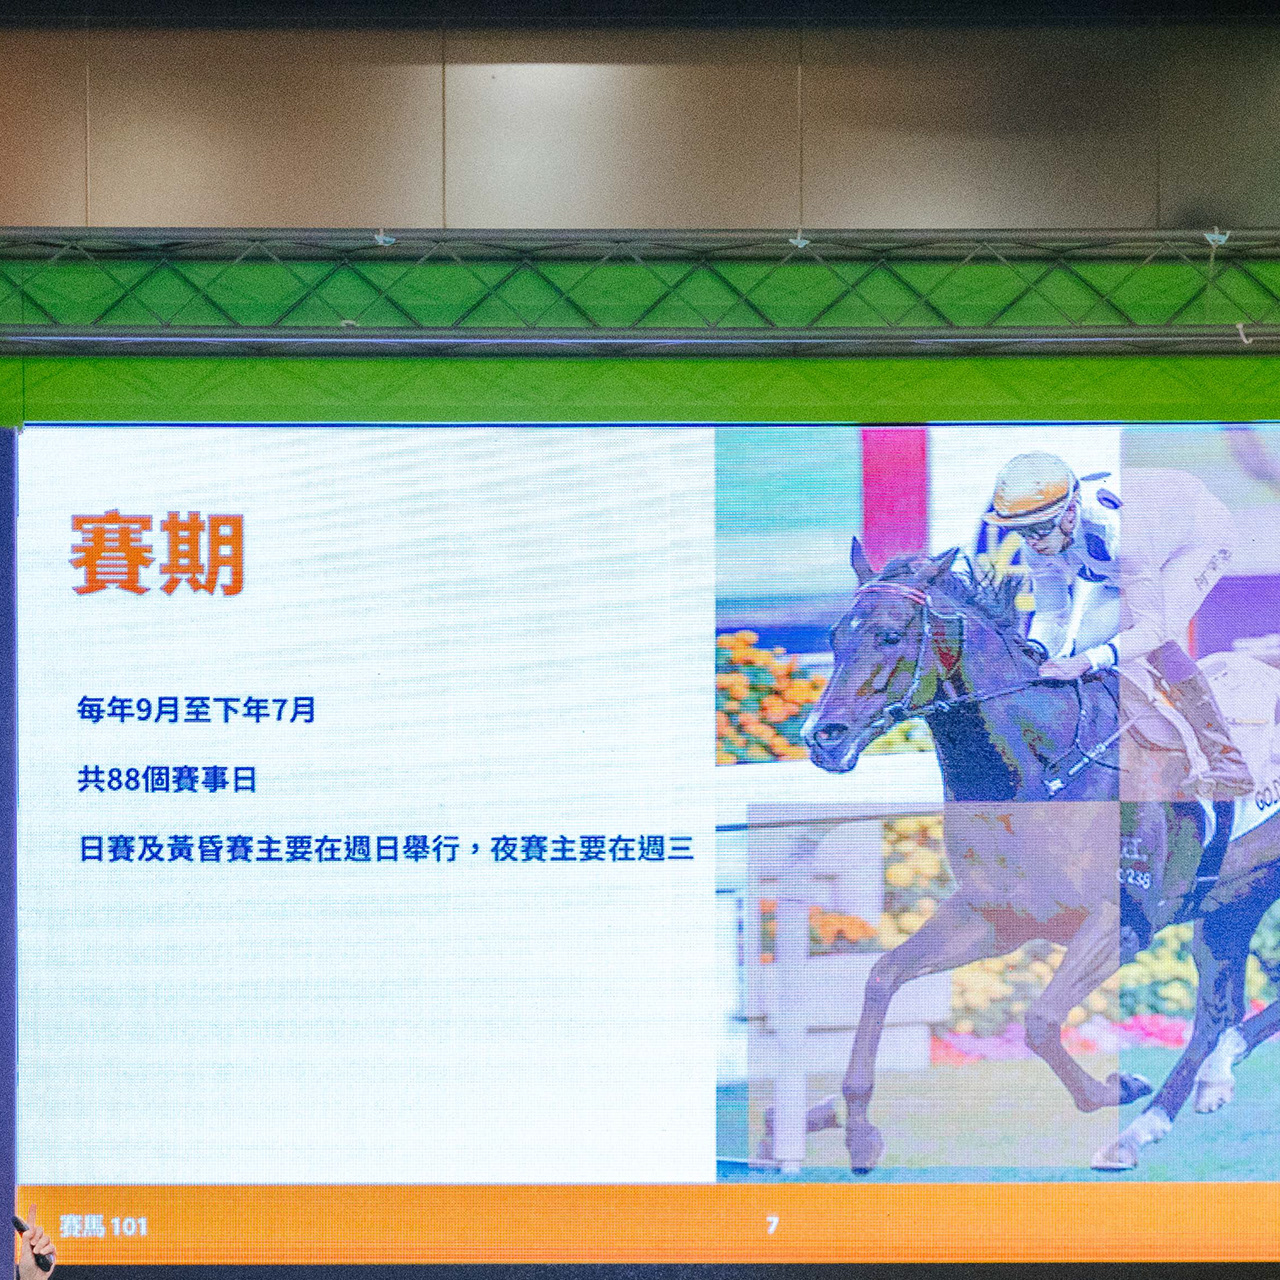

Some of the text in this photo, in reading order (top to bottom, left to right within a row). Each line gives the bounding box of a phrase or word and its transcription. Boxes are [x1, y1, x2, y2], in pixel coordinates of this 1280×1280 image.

[69, 509, 246, 597] 賽期
[76, 694, 316, 725] 每年9月至下年7月
[76, 764, 257, 794] 共88個賽事日
[111, 1216, 148, 1236] 101
[766, 1216, 780, 1234] 7
